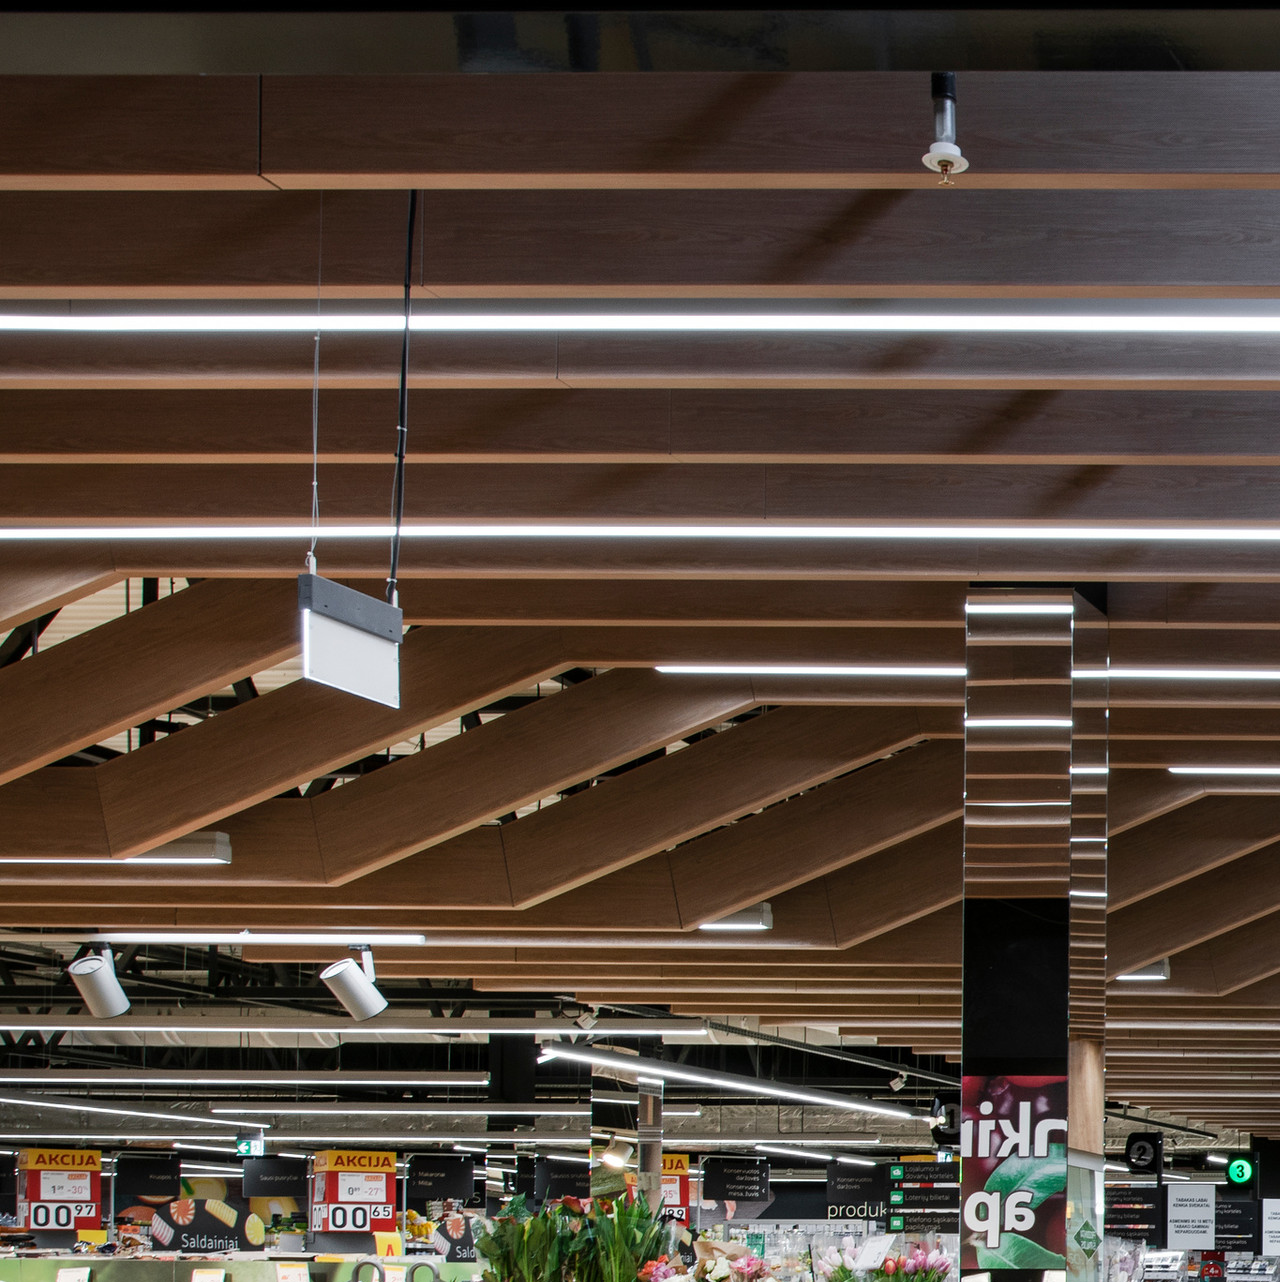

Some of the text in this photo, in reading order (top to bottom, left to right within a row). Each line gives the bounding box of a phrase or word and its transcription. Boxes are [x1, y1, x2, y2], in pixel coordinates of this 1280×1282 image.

[1136, 1145, 1148, 1161] 2
[35, 1154, 97, 1166] AKCIJA
[334, 1156, 392, 1168] AKCIJA
[662, 1159, 685, 1171] IJA
[1236, 1164, 1245, 1178] 3
[181, 1233, 240, 1249] Saldainiai
